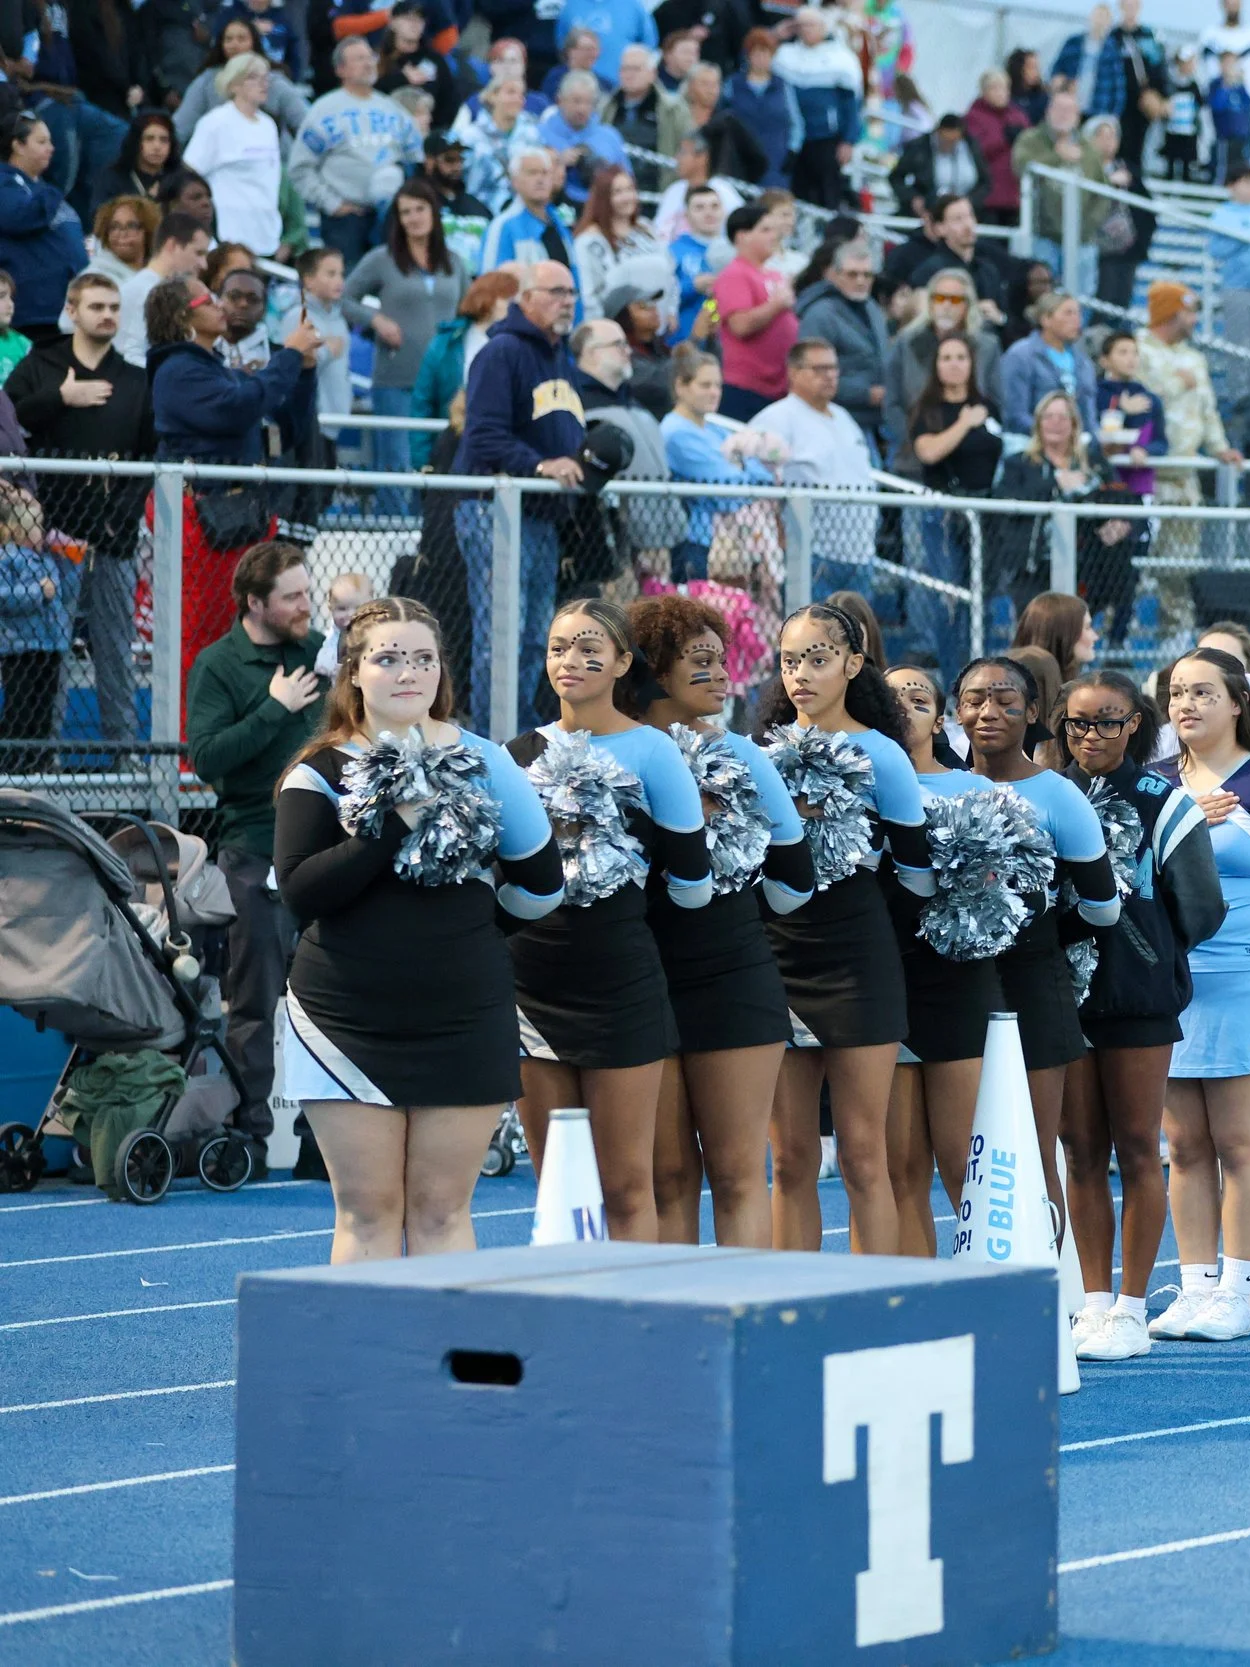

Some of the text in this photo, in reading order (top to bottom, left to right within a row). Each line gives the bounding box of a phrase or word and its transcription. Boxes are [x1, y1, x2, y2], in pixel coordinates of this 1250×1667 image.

[988, 1148, 1016, 1231] BLUE
[953, 1229, 972, 1255] OP!
[823, 1333, 975, 1648] T
